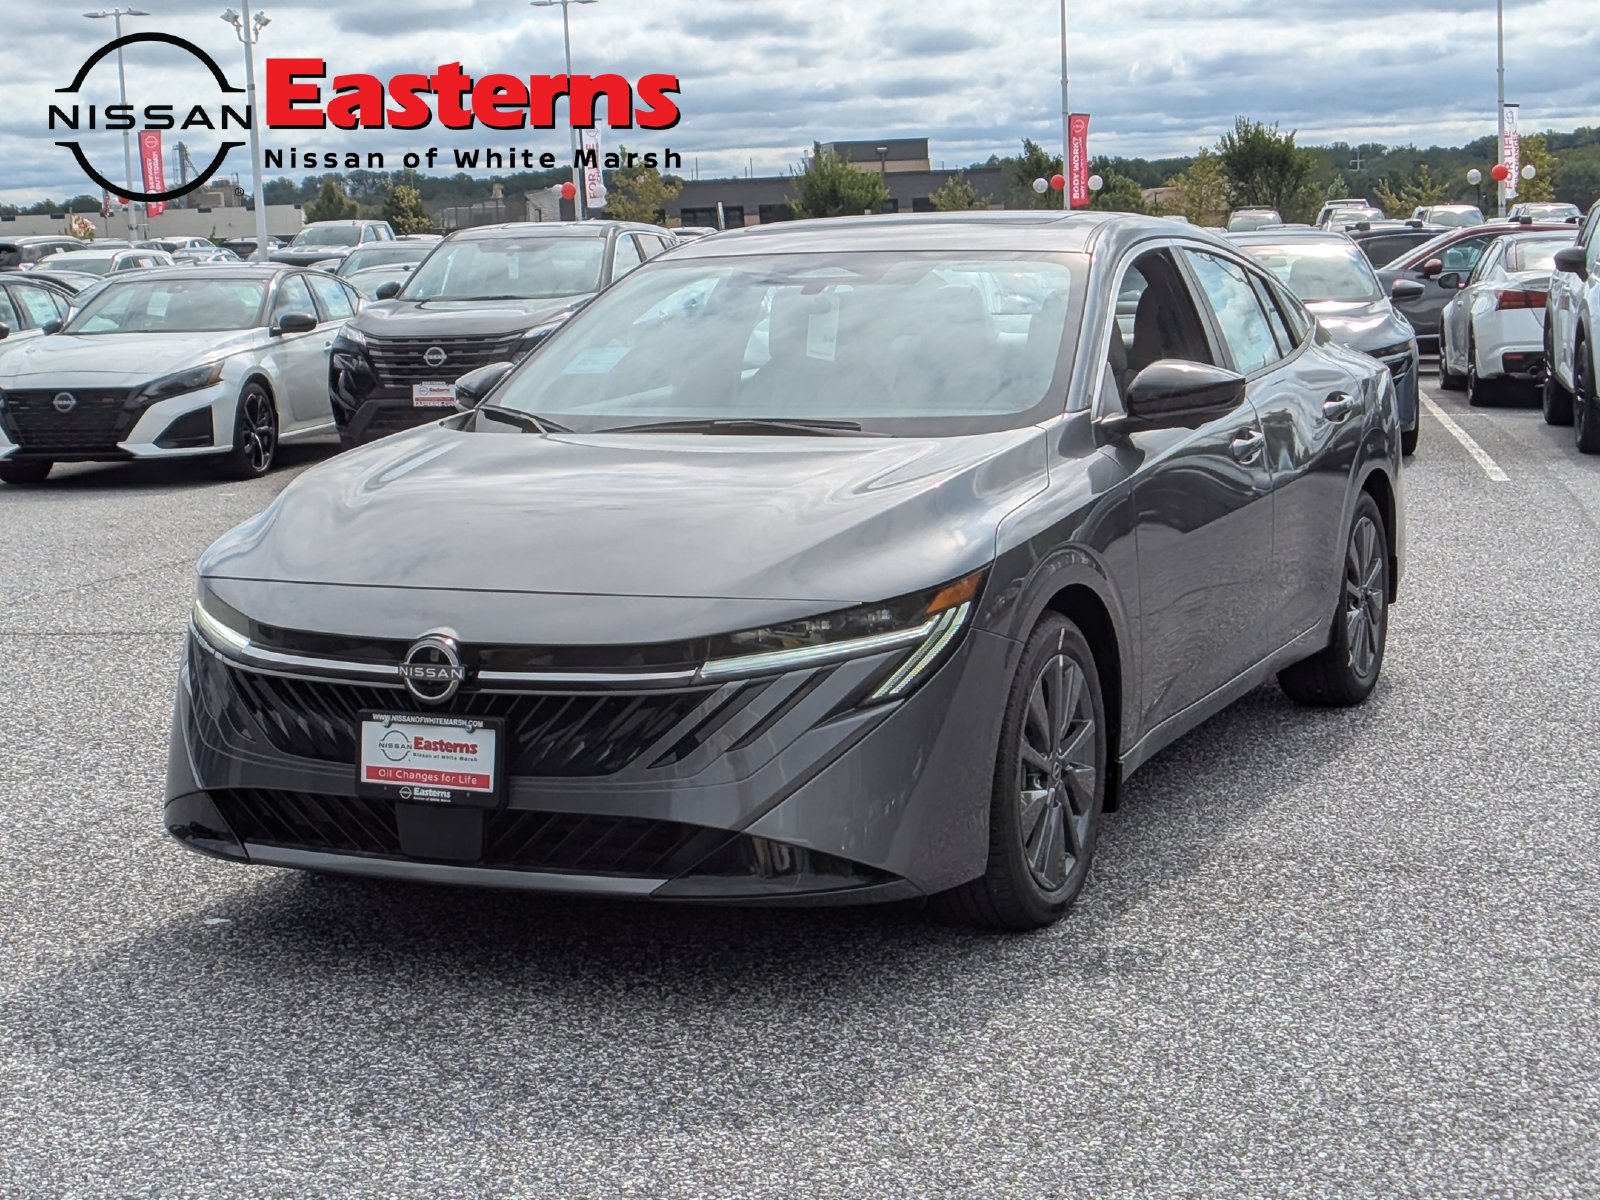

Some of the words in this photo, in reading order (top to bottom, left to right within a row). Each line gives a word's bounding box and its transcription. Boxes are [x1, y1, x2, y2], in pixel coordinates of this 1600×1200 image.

[400, 666, 464, 678] NISSAN
[379, 742, 412, 750] NISSAN
[414, 736, 478, 754] Easterns
[378, 769, 392, 777] Oil
[396, 770, 438, 782] Changes
[441, 773, 455, 783] for
[459, 775, 477, 785] Life
[414, 787, 451, 798] Easterns
